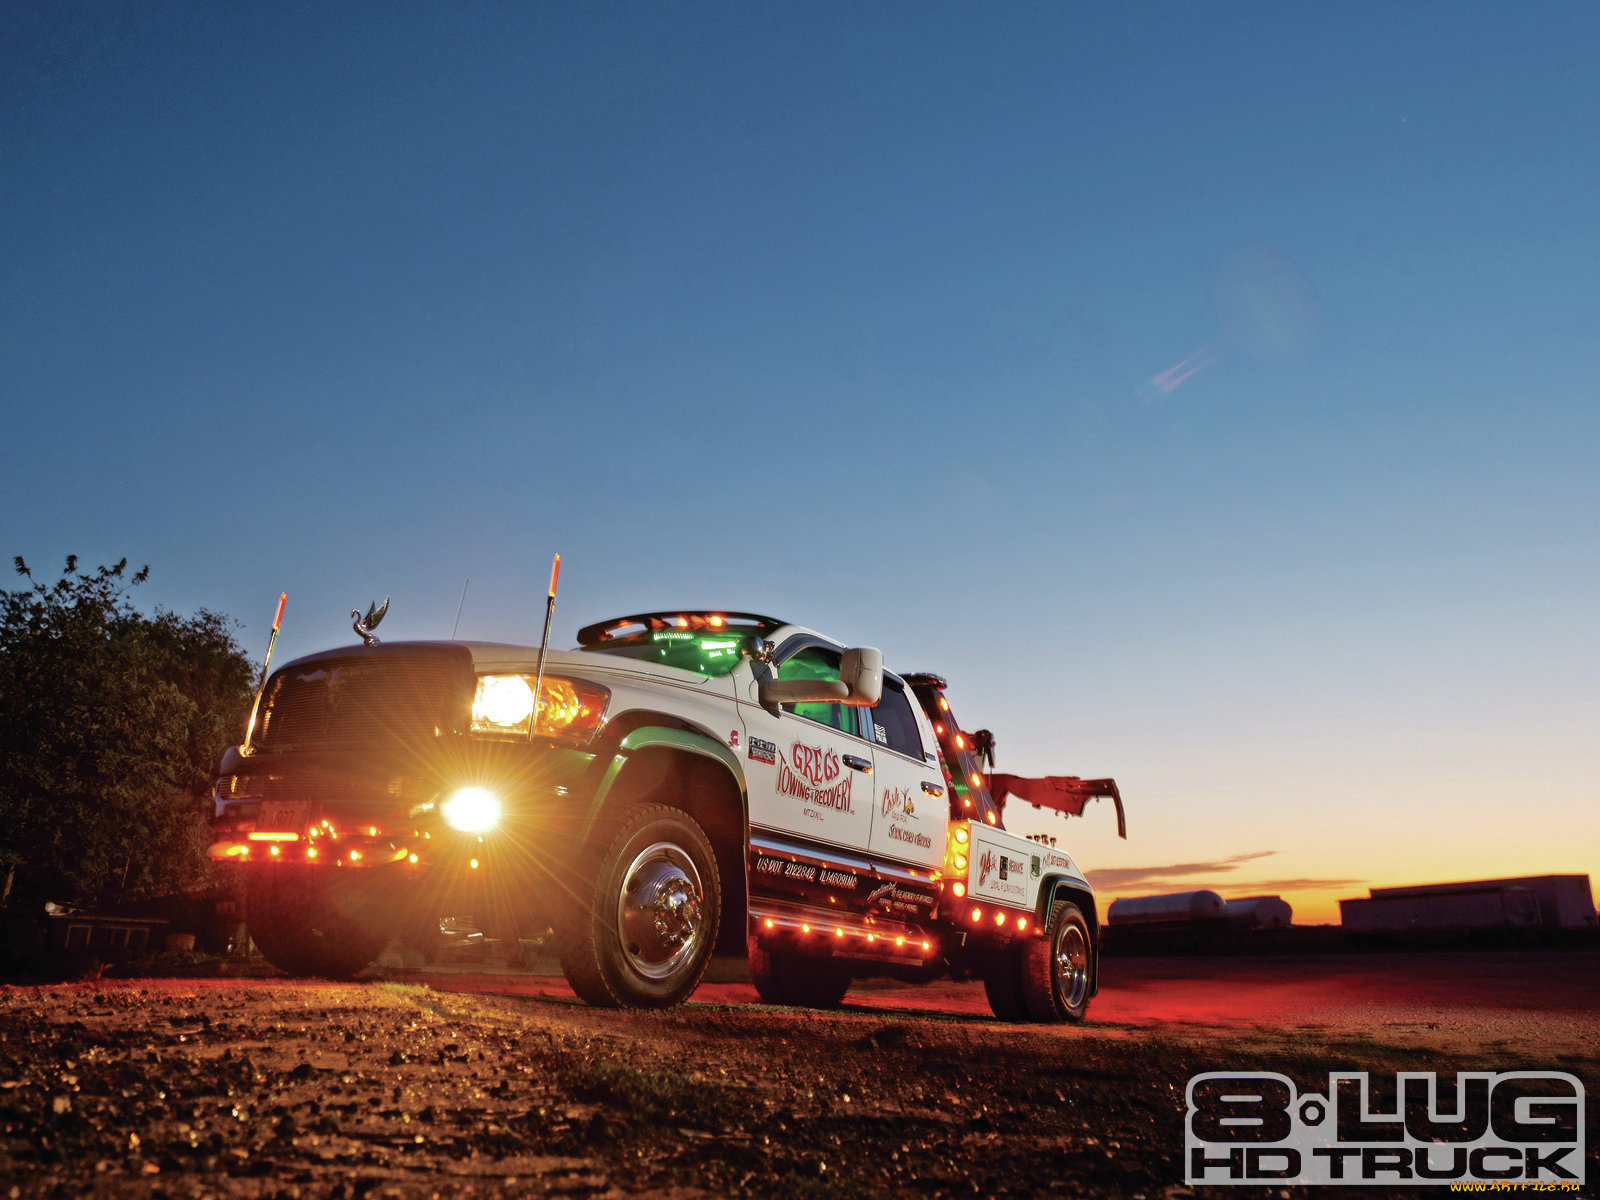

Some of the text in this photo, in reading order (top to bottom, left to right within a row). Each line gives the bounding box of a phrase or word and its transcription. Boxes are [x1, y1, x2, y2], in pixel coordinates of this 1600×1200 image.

[777, 749, 810, 800] TOWING
[814, 770, 853, 812] RECOVERY
[792, 742, 840, 787] GREG'S
